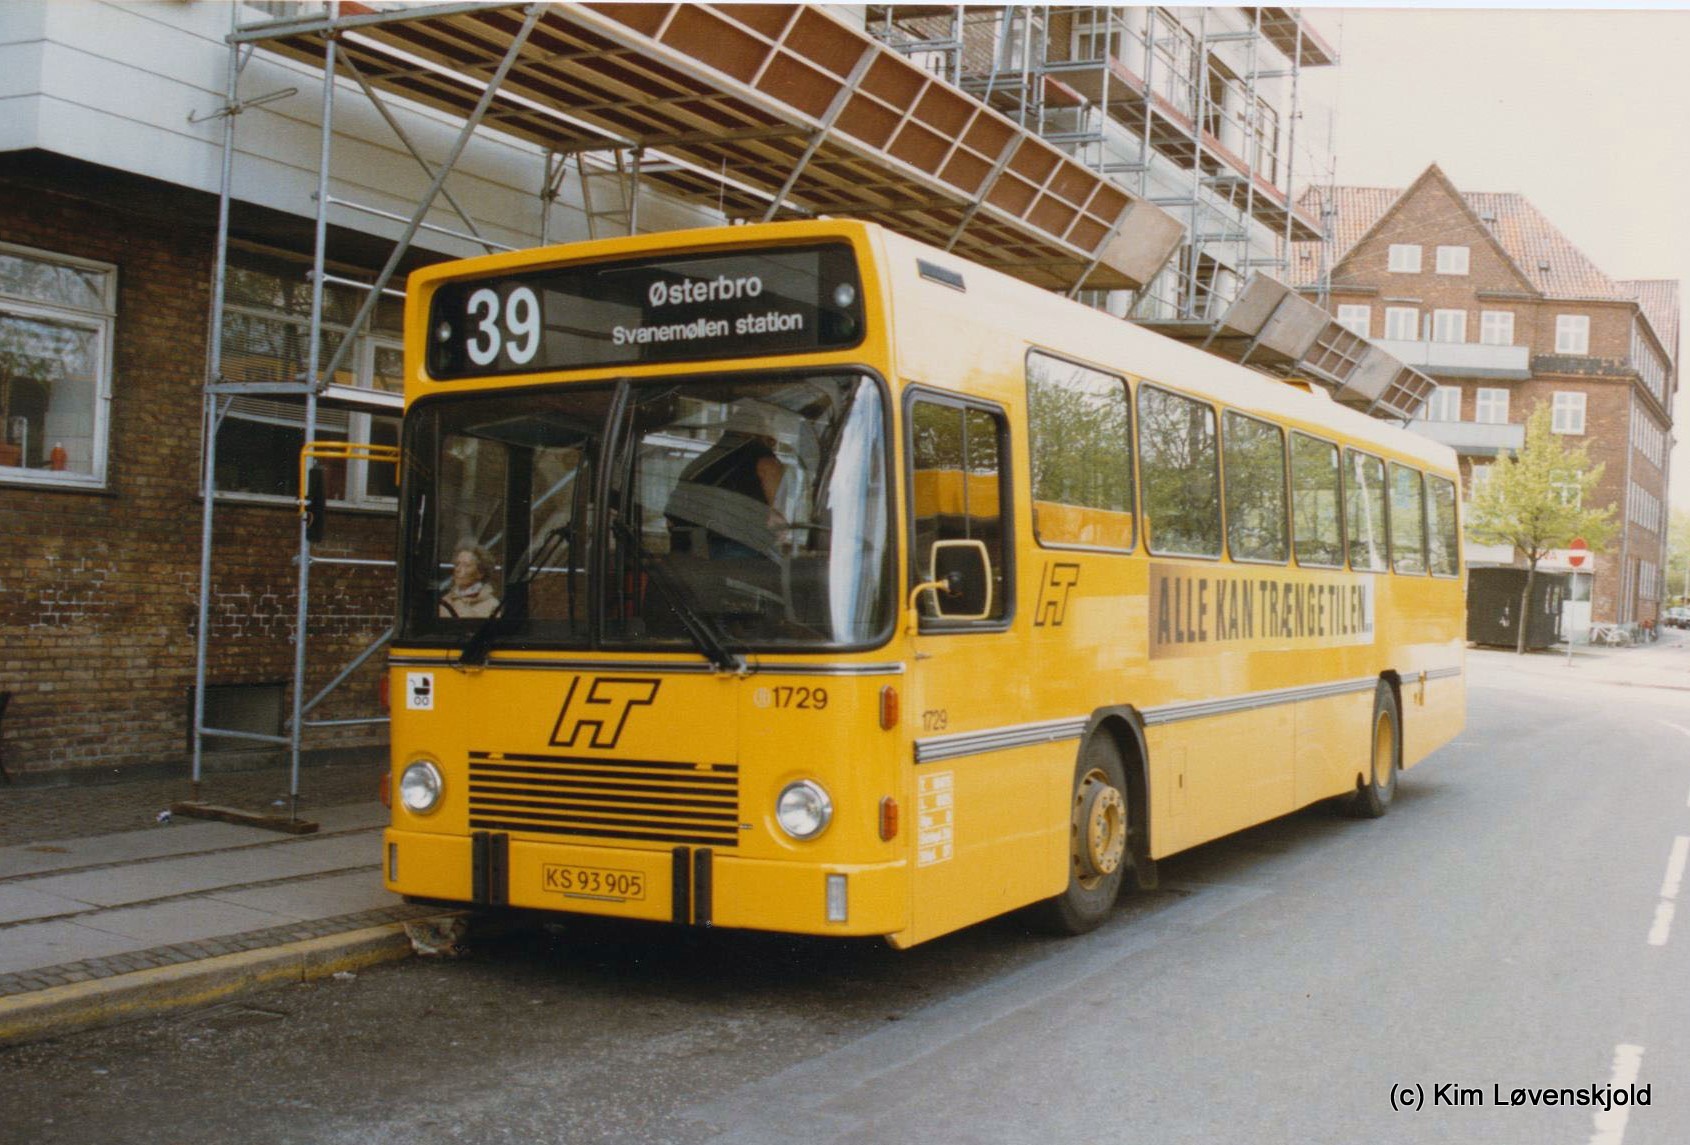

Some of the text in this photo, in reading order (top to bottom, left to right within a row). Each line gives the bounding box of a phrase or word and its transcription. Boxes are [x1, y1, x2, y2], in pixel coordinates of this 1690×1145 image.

[648, 274, 763, 307] Østerbro
[466, 287, 541, 366] 39
[612, 311, 803, 345] Svanemøllen station
[1157, 577, 1208, 644] ALLE
[1216, 579, 1254, 641] KAN
[1259, 580, 1324, 638] TRÆNGE
[1328, 585, 1348, 636] TIL
[548, 676, 662, 749] HT
[773, 686, 828, 710] 1729
[922, 709, 948, 731] 1729
[546, 867, 642, 896] KS 93 905
